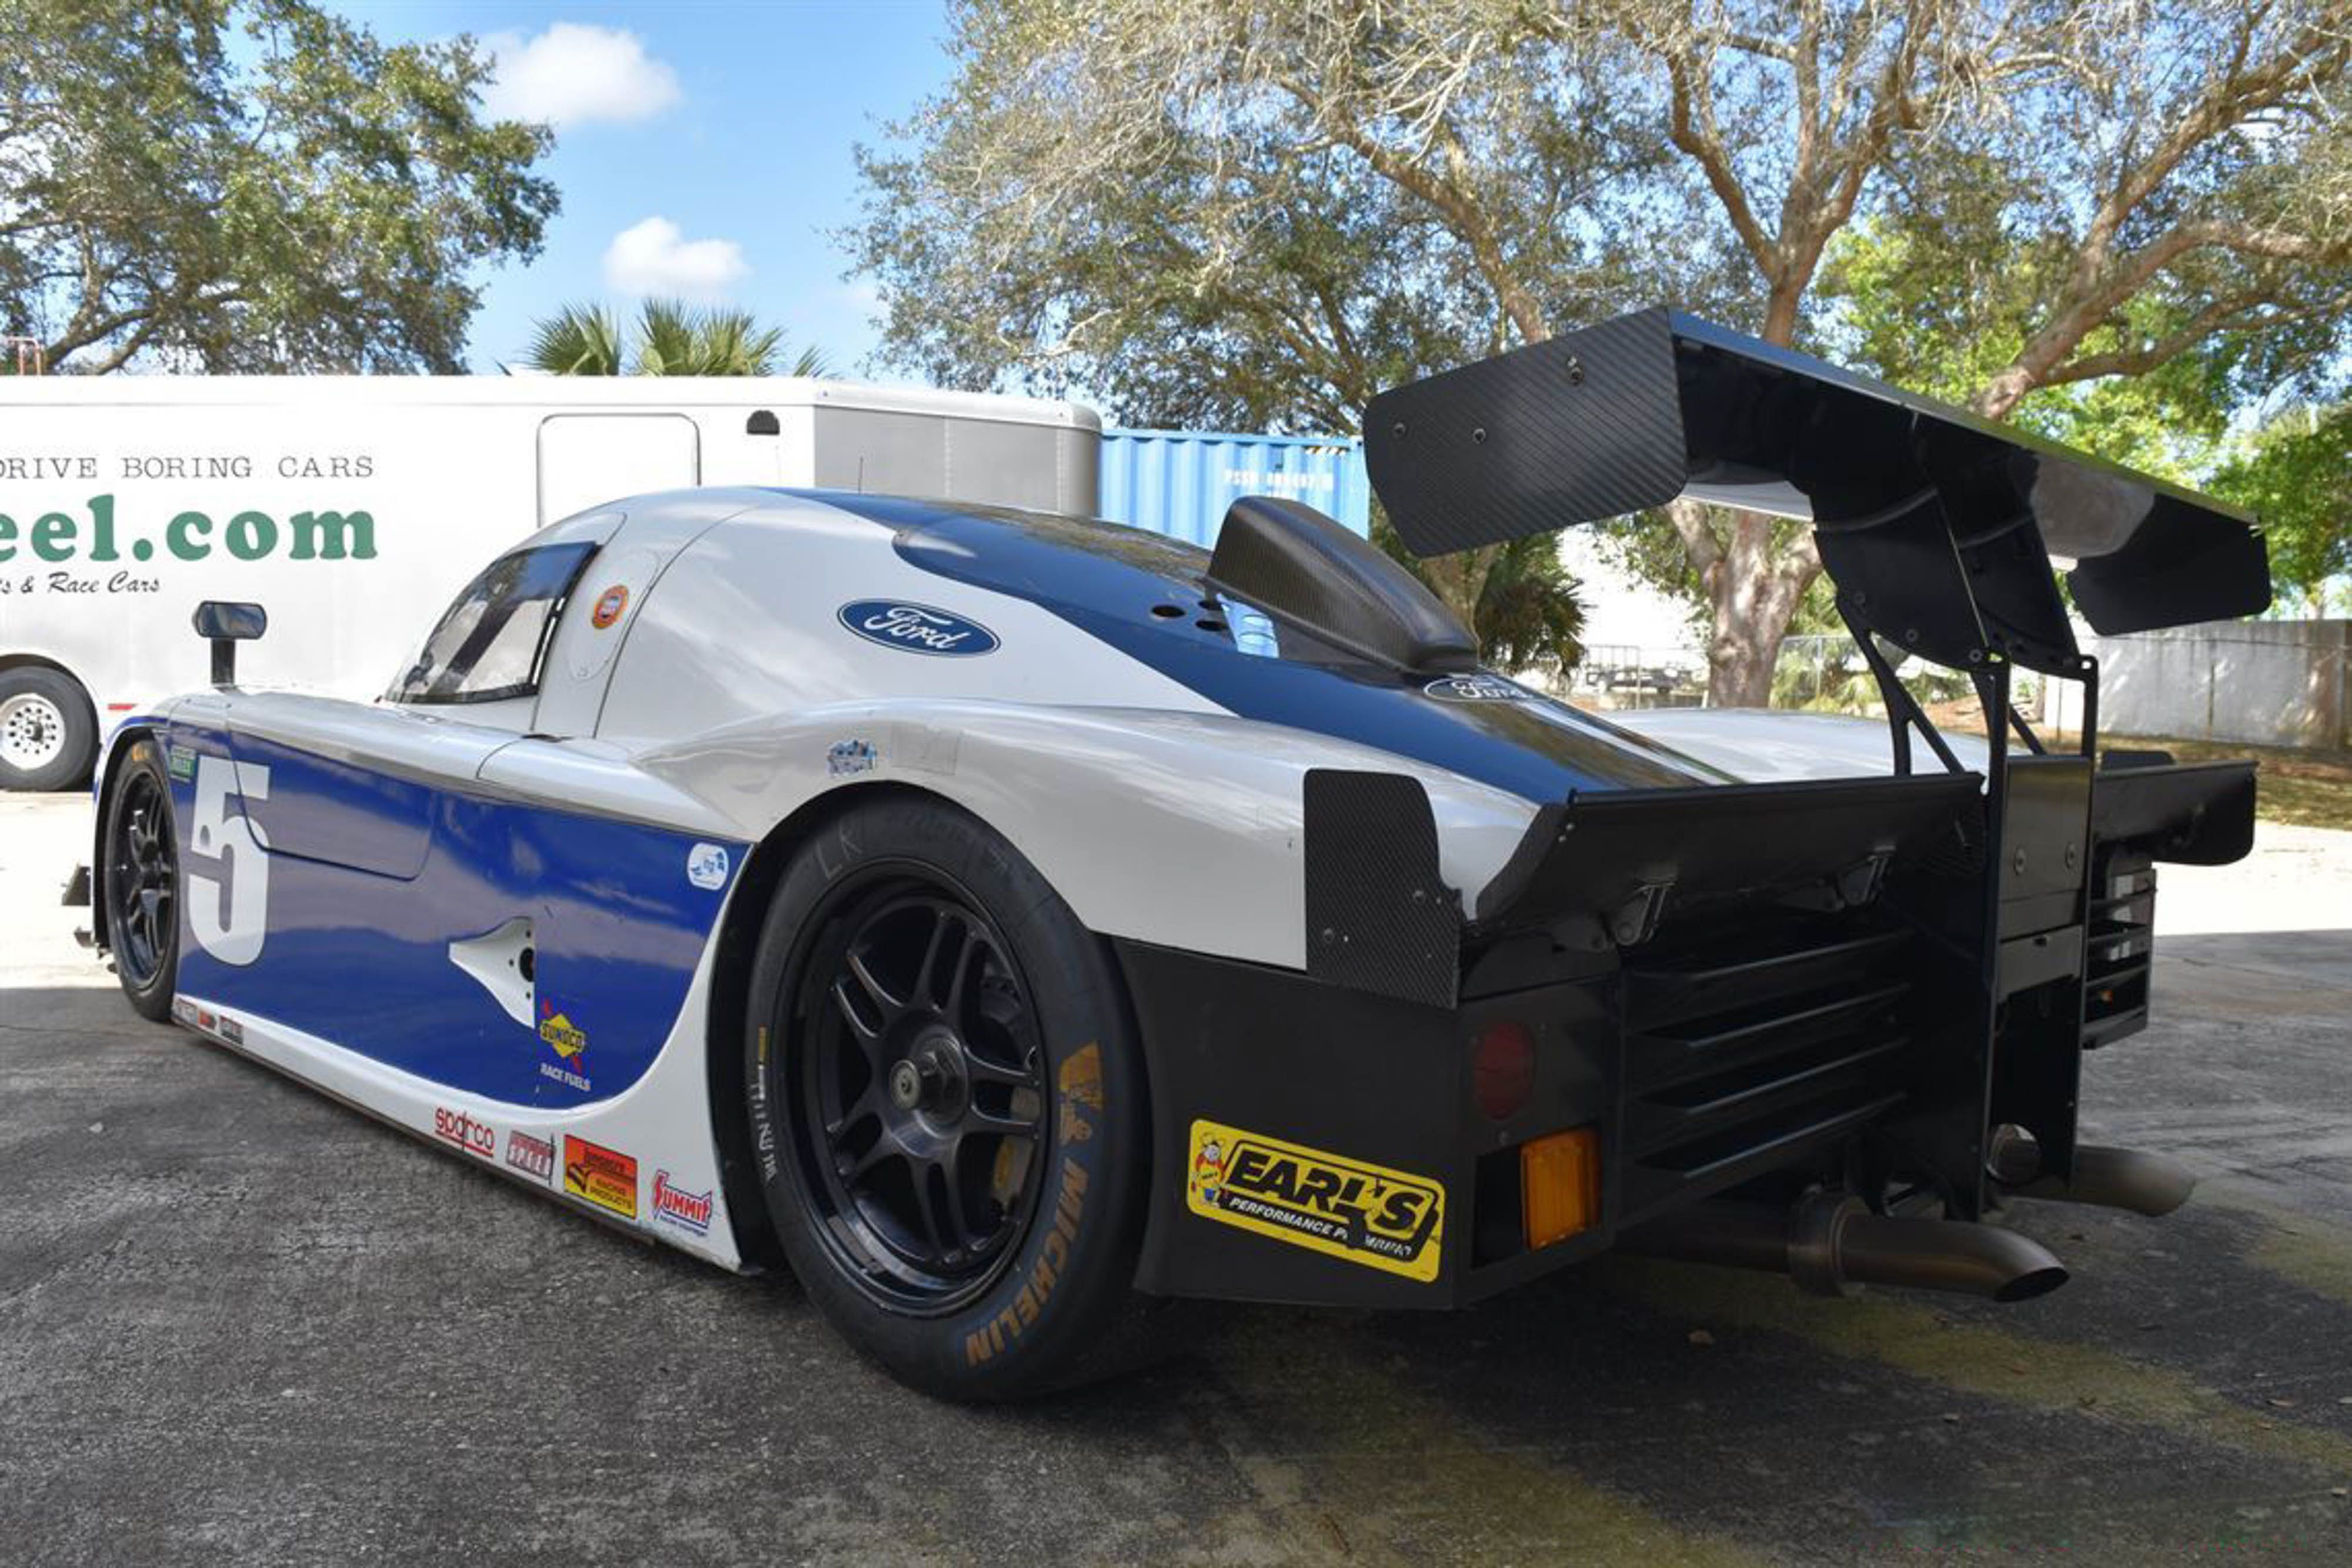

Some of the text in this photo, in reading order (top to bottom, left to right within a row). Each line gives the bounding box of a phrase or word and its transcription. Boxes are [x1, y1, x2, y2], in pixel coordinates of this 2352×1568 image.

[0, 456, 373, 479] RIVE BORING CARS
[20, 576, 35, 594] &
[48, 571, 99, 594] Race
[107, 570, 159, 593] Cars
[863, 606, 971, 649] Ford
[188, 756, 270, 966] 5
[540, 1021, 584, 1050] SUNOCO
[540, 1062, 591, 1092] RACE FUELS
[435, 1107, 495, 1150] sparco
[651, 1169, 711, 1223] SUMMIT
[1227, 1149, 1424, 1231] EARL'S
[1229, 1197, 1333, 1235] PERFORMANCE
[966, 1156, 1089, 1366] MICHELIN
